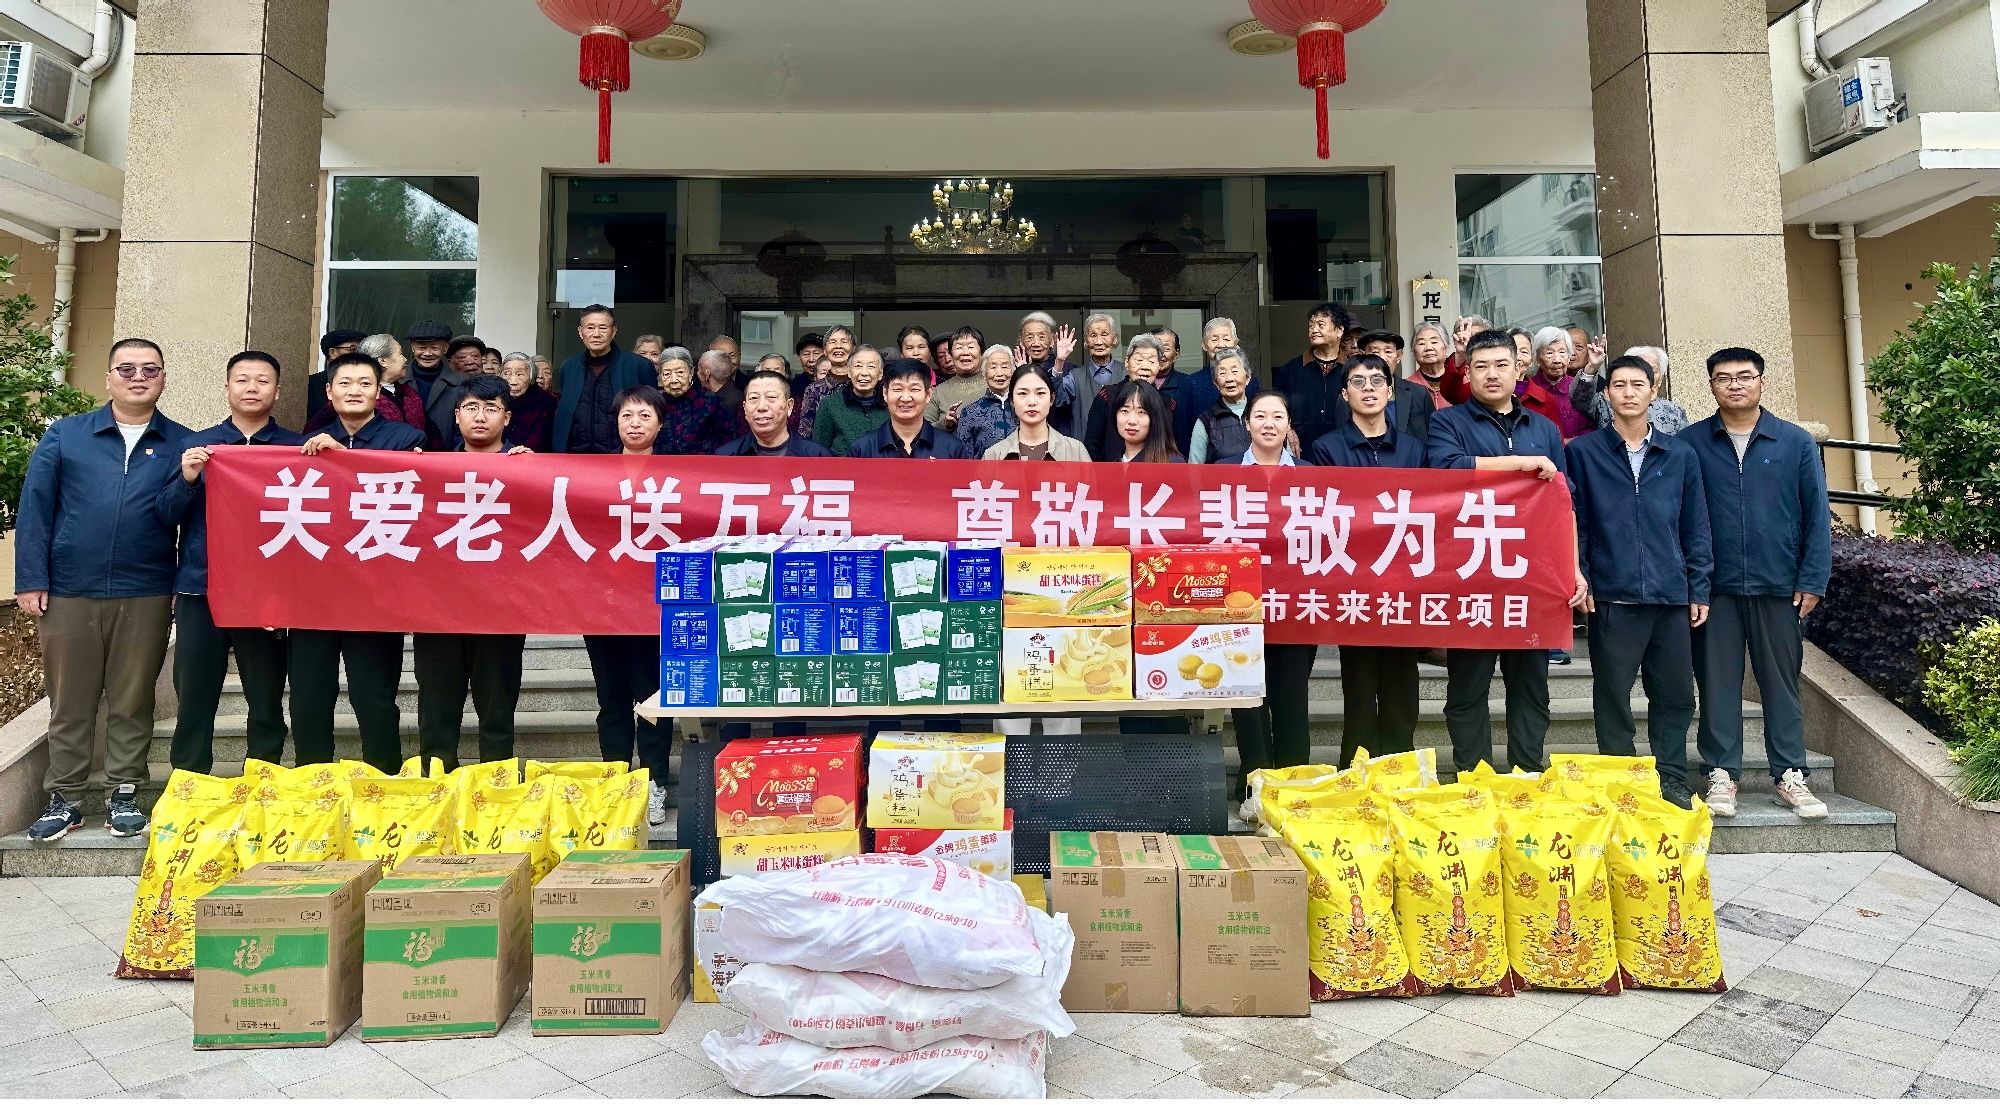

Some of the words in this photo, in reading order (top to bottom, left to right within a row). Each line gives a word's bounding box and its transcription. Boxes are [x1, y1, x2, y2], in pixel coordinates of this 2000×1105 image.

[258, 467, 856, 563] 关爱老人送万福
[951, 479, 1529, 580] 尊敬长辈敬为先
[1039, 573, 1102, 588] 甜玉米味蛋糕
